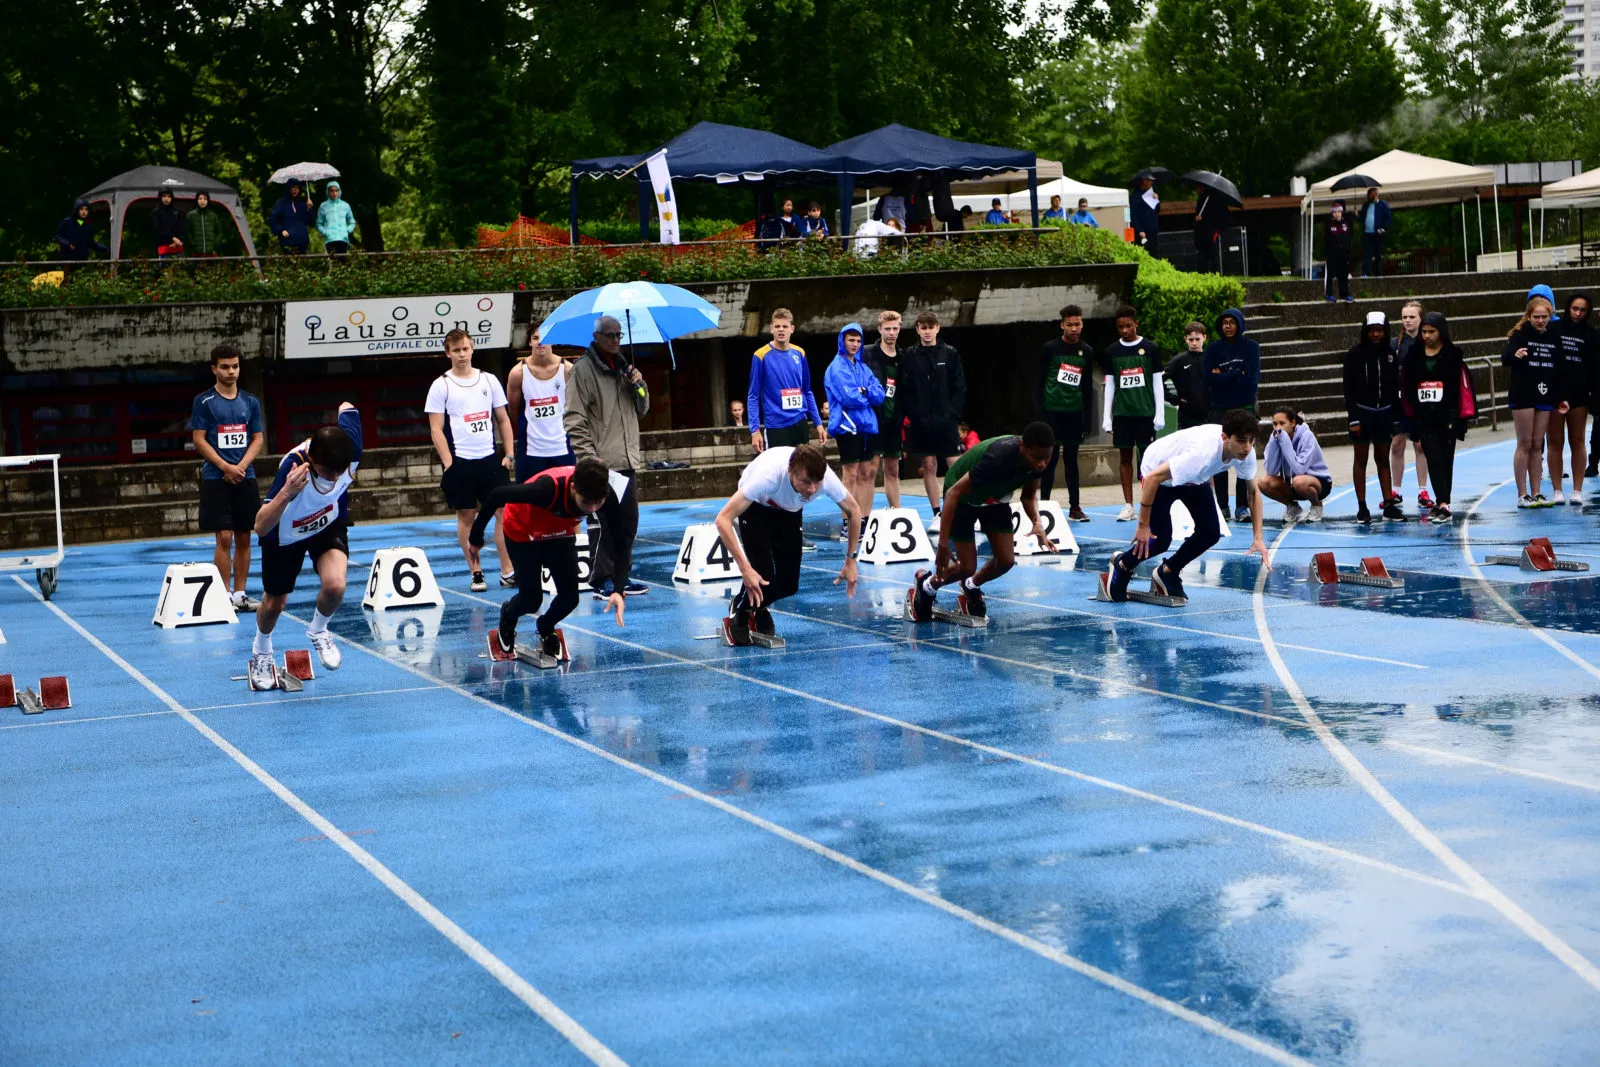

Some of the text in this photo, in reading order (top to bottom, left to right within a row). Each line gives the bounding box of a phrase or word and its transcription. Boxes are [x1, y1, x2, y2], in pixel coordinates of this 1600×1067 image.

[309, 319, 492, 341] Lausanne
[368, 340, 422, 351] CAPITALE
[1062, 372, 1079, 384] 266
[1122, 376, 1141, 386] 279
[886, 386, 895, 396] 75
[1421, 389, 1437, 400] 261
[787, 396, 802, 407] 153
[535, 406, 556, 418] 323
[471, 421, 489, 433] 321
[223, 434, 245, 446] 152
[298, 515, 329, 534] 320
[1036, 510, 1060, 545] 2
[866, 518, 879, 555] 3
[890, 517, 917, 554] 3
[681, 536, 693, 572] 4
[706, 536, 734, 571] 4
[370, 559, 380, 598] 6
[392, 558, 422, 598] 6
[160, 577, 172, 616] 7
[184, 576, 213, 616] 7
